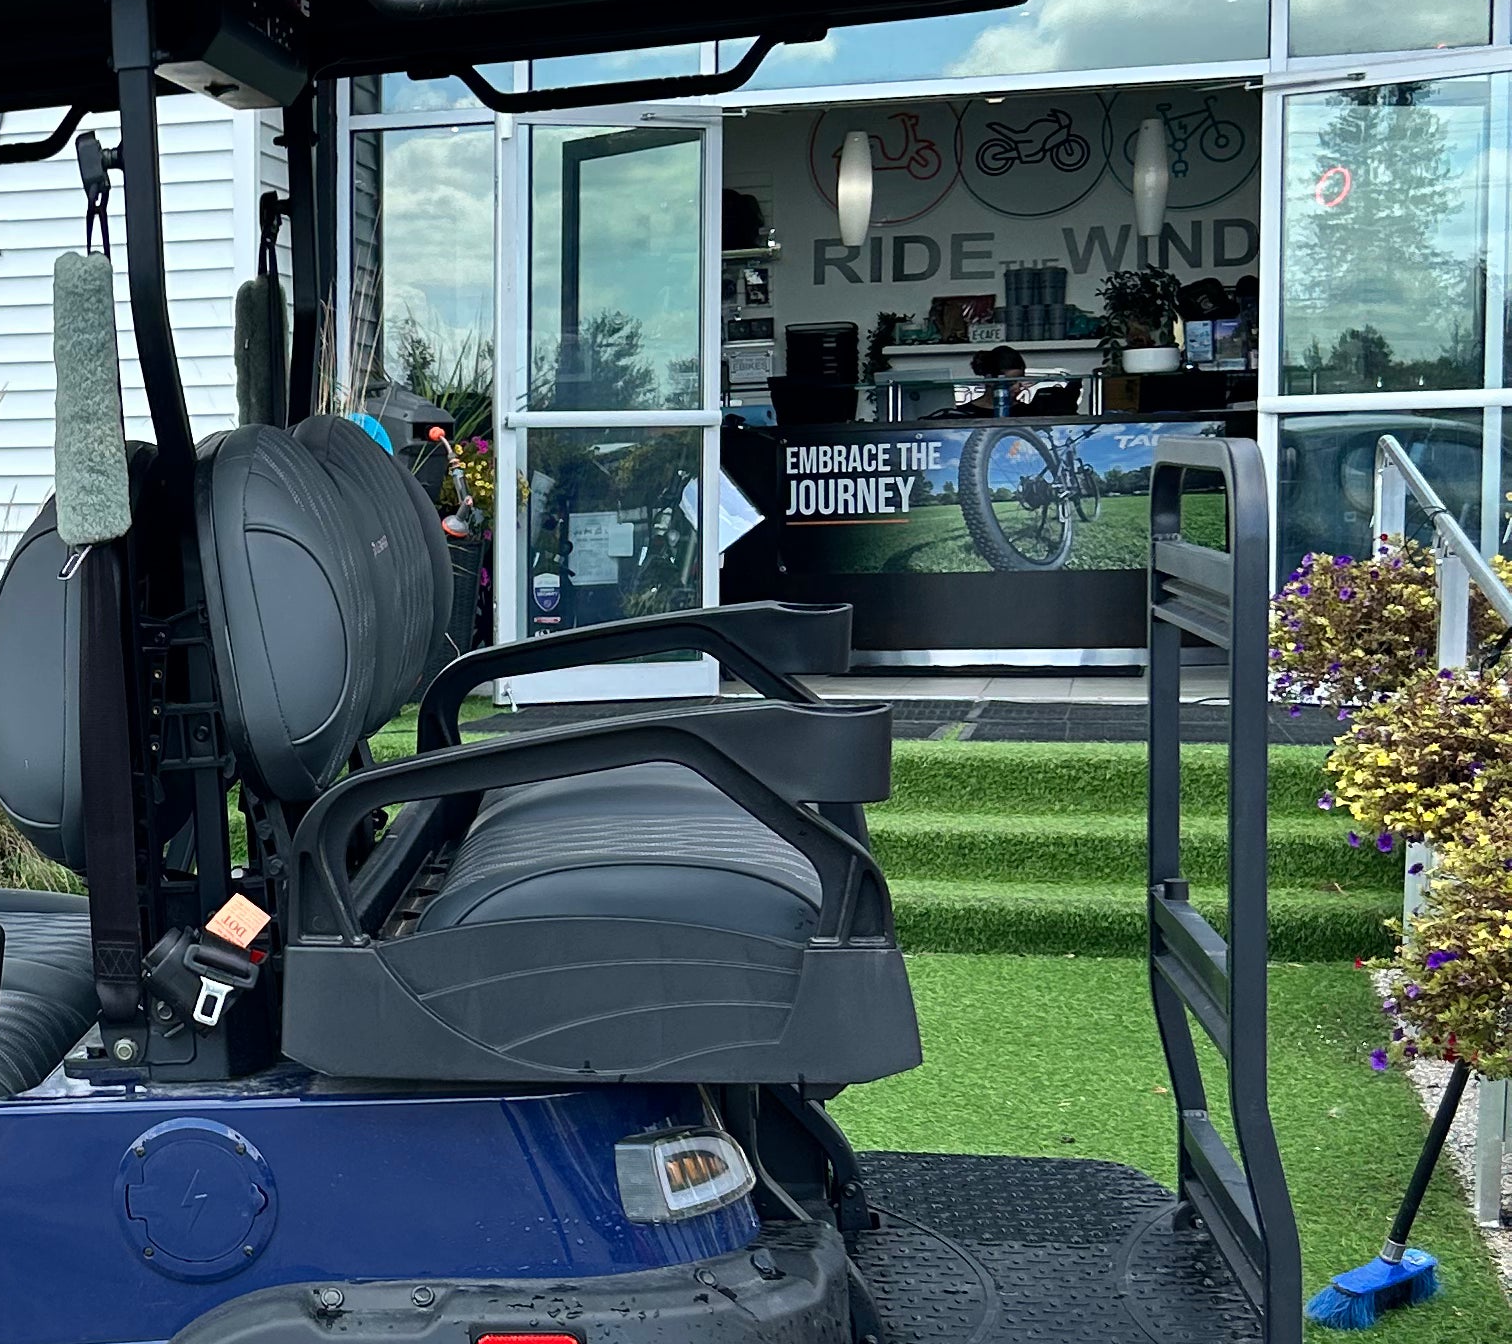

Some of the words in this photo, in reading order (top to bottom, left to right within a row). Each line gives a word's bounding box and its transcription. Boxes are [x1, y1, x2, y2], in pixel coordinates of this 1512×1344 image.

[813, 232, 995, 286] RIDE
[1061, 218, 1260, 275] WIND
[972, 328, 1001, 341] E-CAFE
[786, 443, 891, 475] EMBRACE
[896, 441, 943, 471] THE
[785, 476, 916, 516] JOURNEY
[222, 915, 247, 938] DOT
